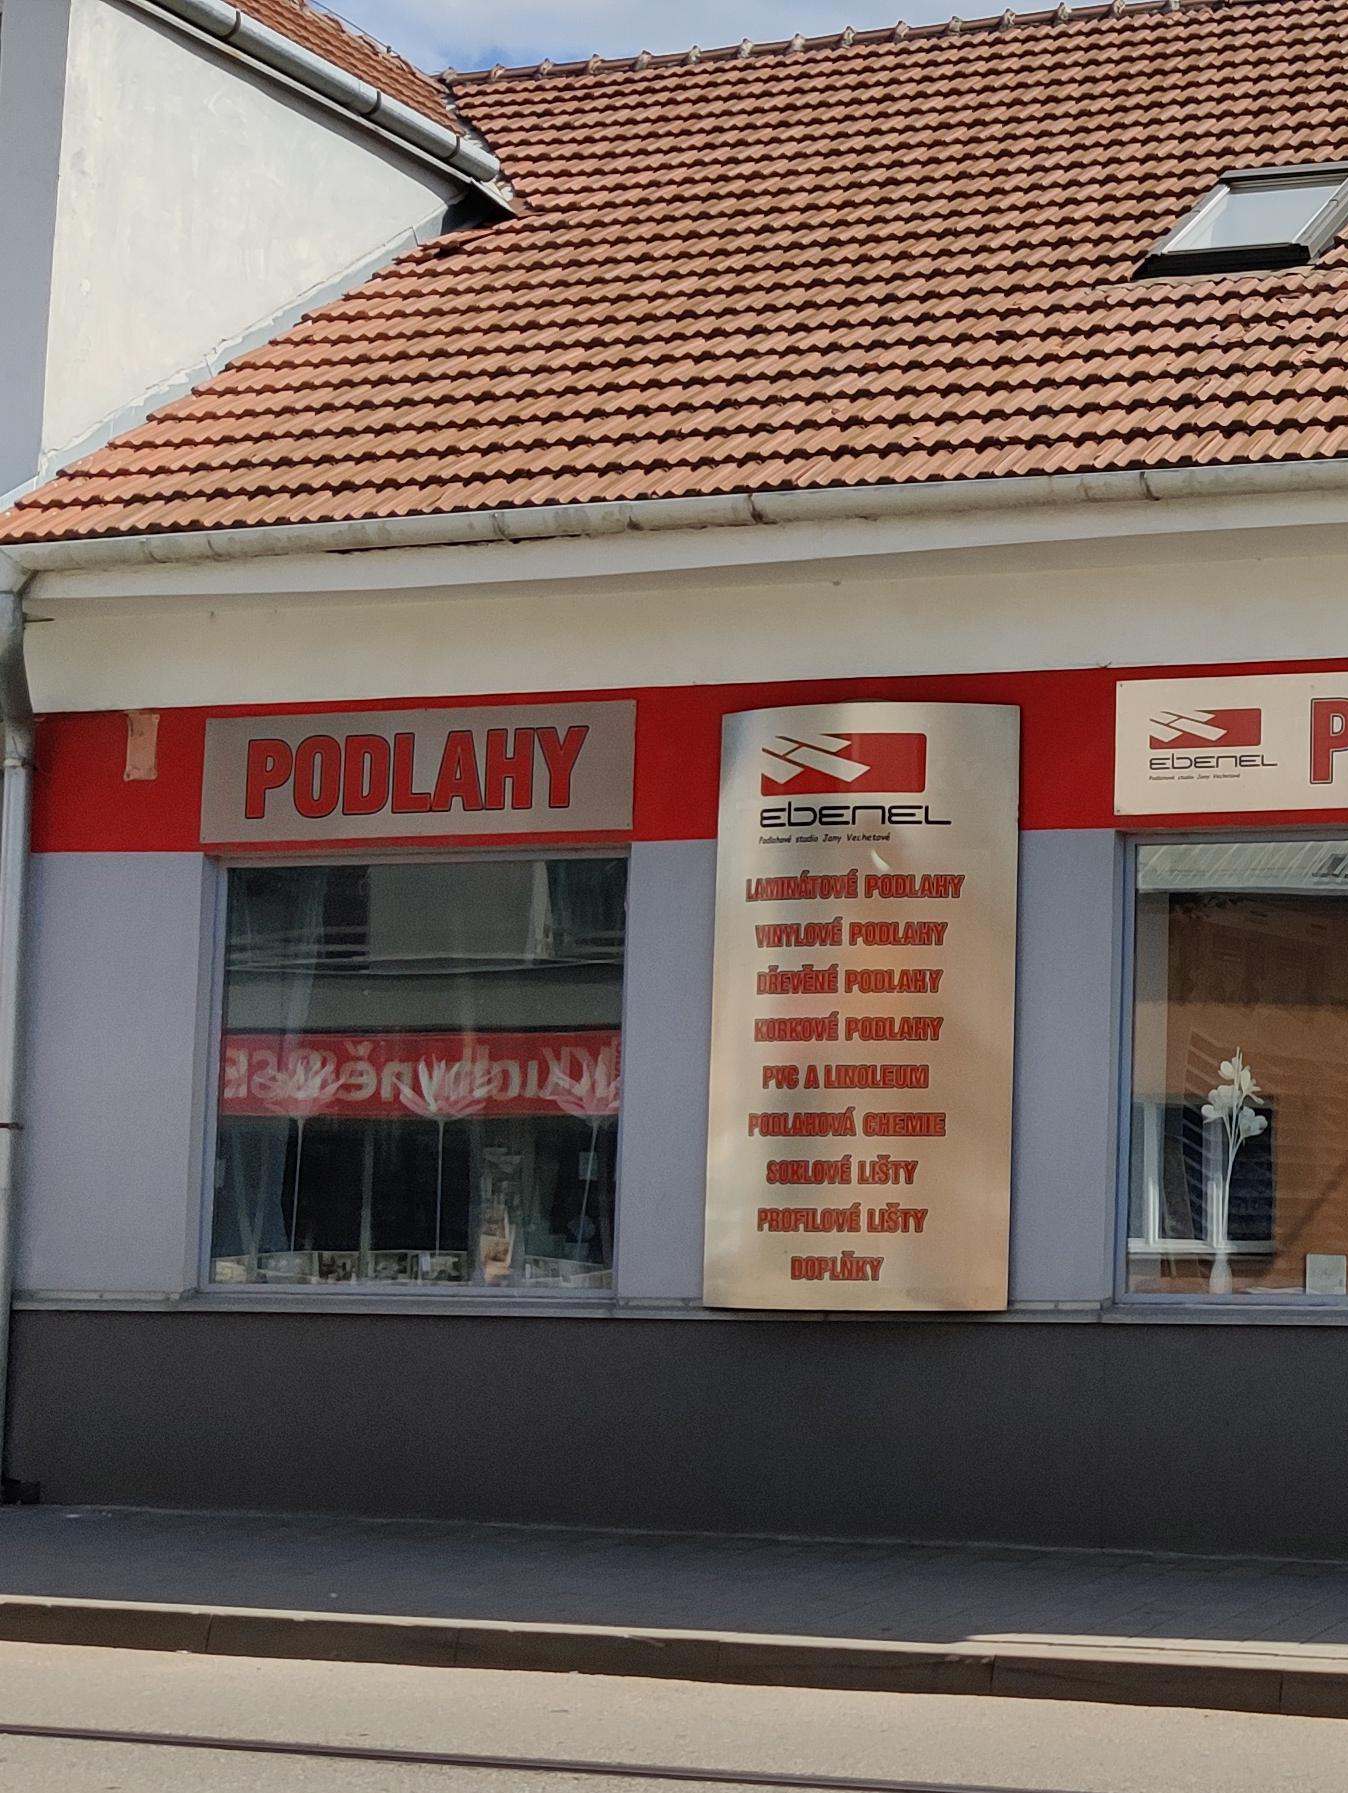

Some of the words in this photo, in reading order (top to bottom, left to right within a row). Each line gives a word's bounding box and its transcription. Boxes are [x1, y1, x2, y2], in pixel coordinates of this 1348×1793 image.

[245, 725, 590, 819] PODLAHY
[745, 869, 859, 902] LAMINÁTOVÉ
[864, 874, 965, 899] PODLAHY
[755, 916, 843, 948] VINYLOVÉ
[849, 921, 948, 946] PODLAHY
[757, 964, 839, 994] DŘEVĚNÉ
[844, 968, 944, 993] PODLAHY
[754, 1011, 839, 1042] KORKOVÉ
[844, 1016, 944, 1041] PODLAHY
[762, 1065, 799, 1089] PVC
[804, 1065, 820, 1089] A
[823, 1064, 929, 1089] LINOLEUM
[748, 1107, 857, 1137] PODLAHOVÁ
[862, 1112, 947, 1137] CHEMIE
[766, 1154, 852, 1185] SOKLOVÉ
[857, 1154, 919, 1185] LIŠTY
[757, 1202, 861, 1232] PROFILOVÉ
[866, 1202, 928, 1233] LIŠTY
[790, 1250, 885, 1281] DOPLŇKY
